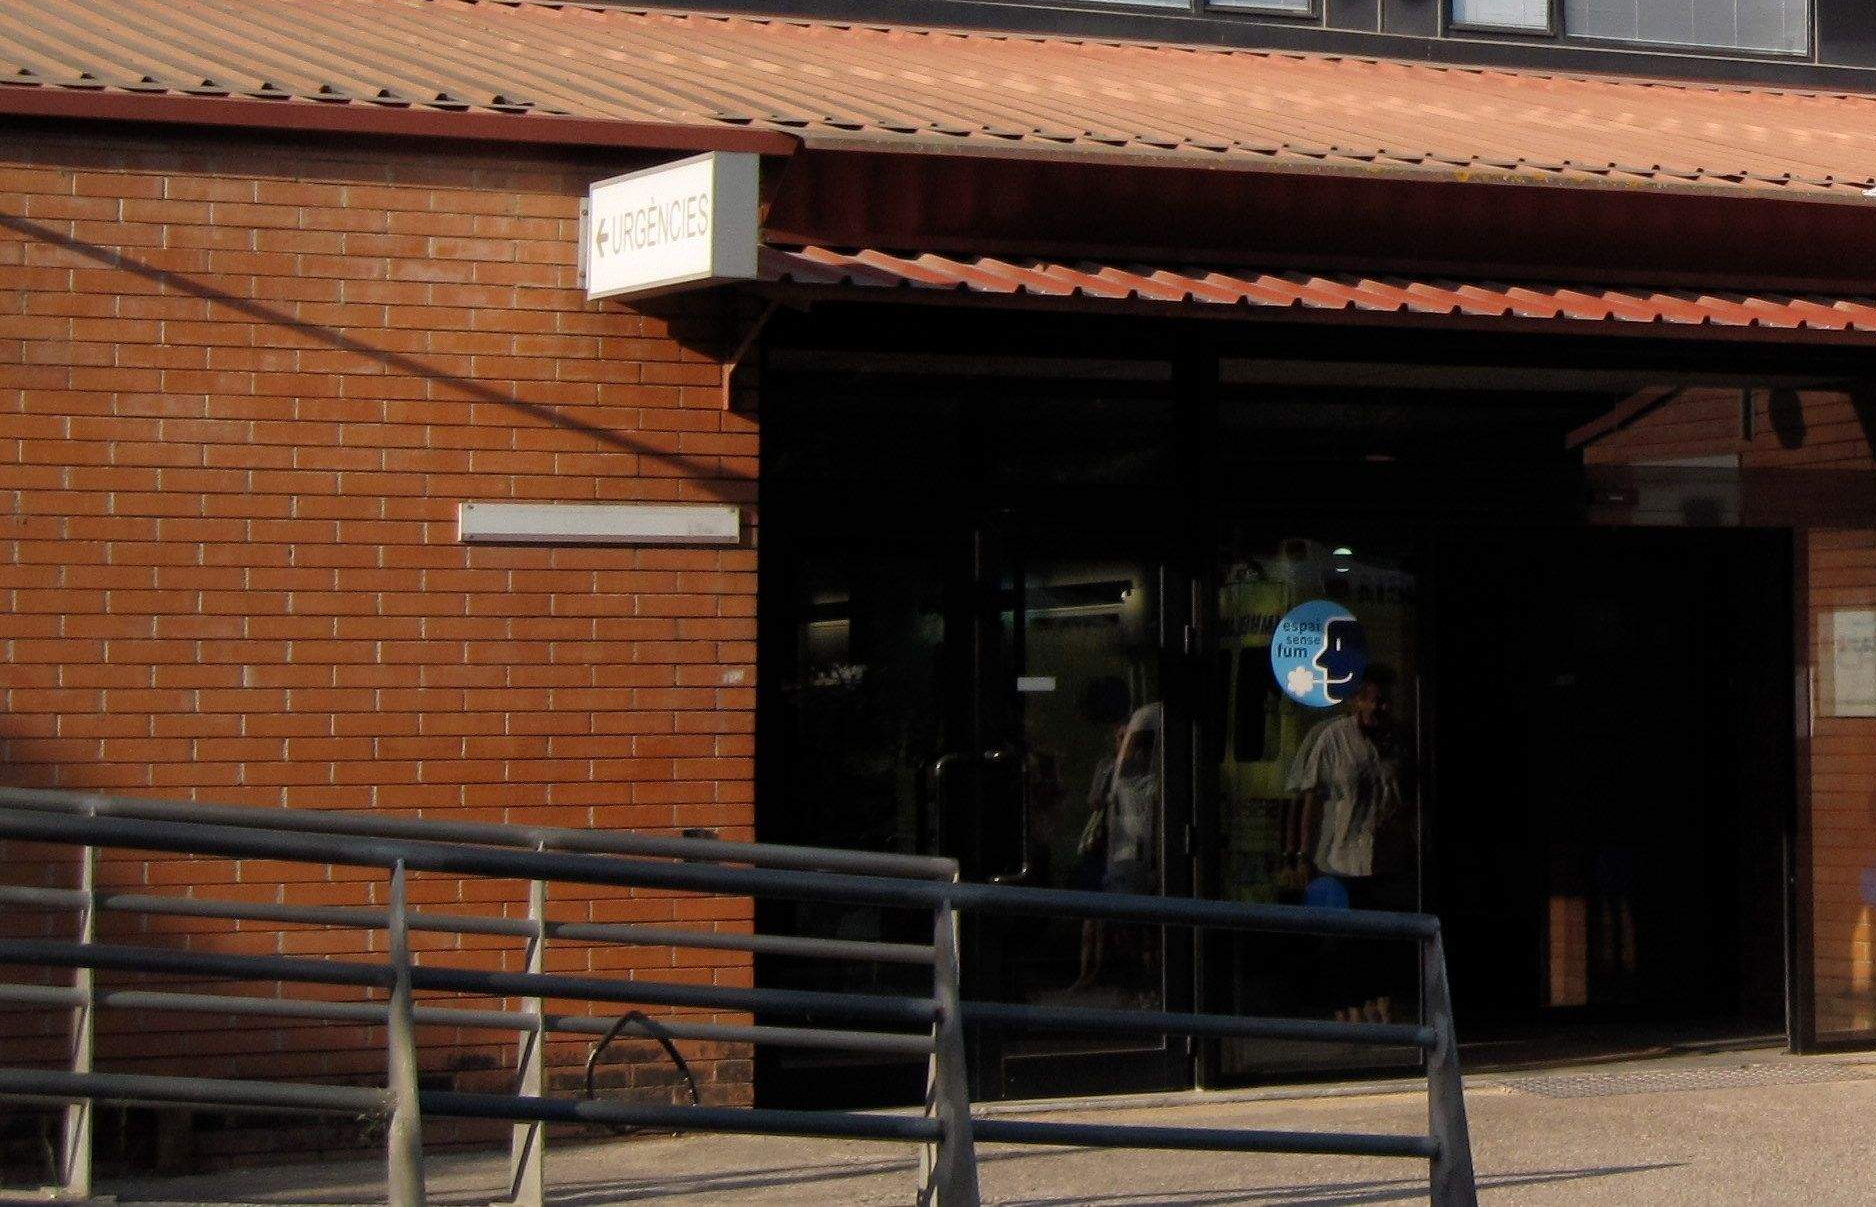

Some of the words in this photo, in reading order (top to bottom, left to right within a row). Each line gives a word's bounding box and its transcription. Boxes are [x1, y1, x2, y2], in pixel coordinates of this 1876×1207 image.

[612, 192, 709, 255] URGÈNCIES
[1283, 618, 1321, 635] espai
[1286, 636, 1321, 645] sense
[1277, 643, 1308, 658] fum
